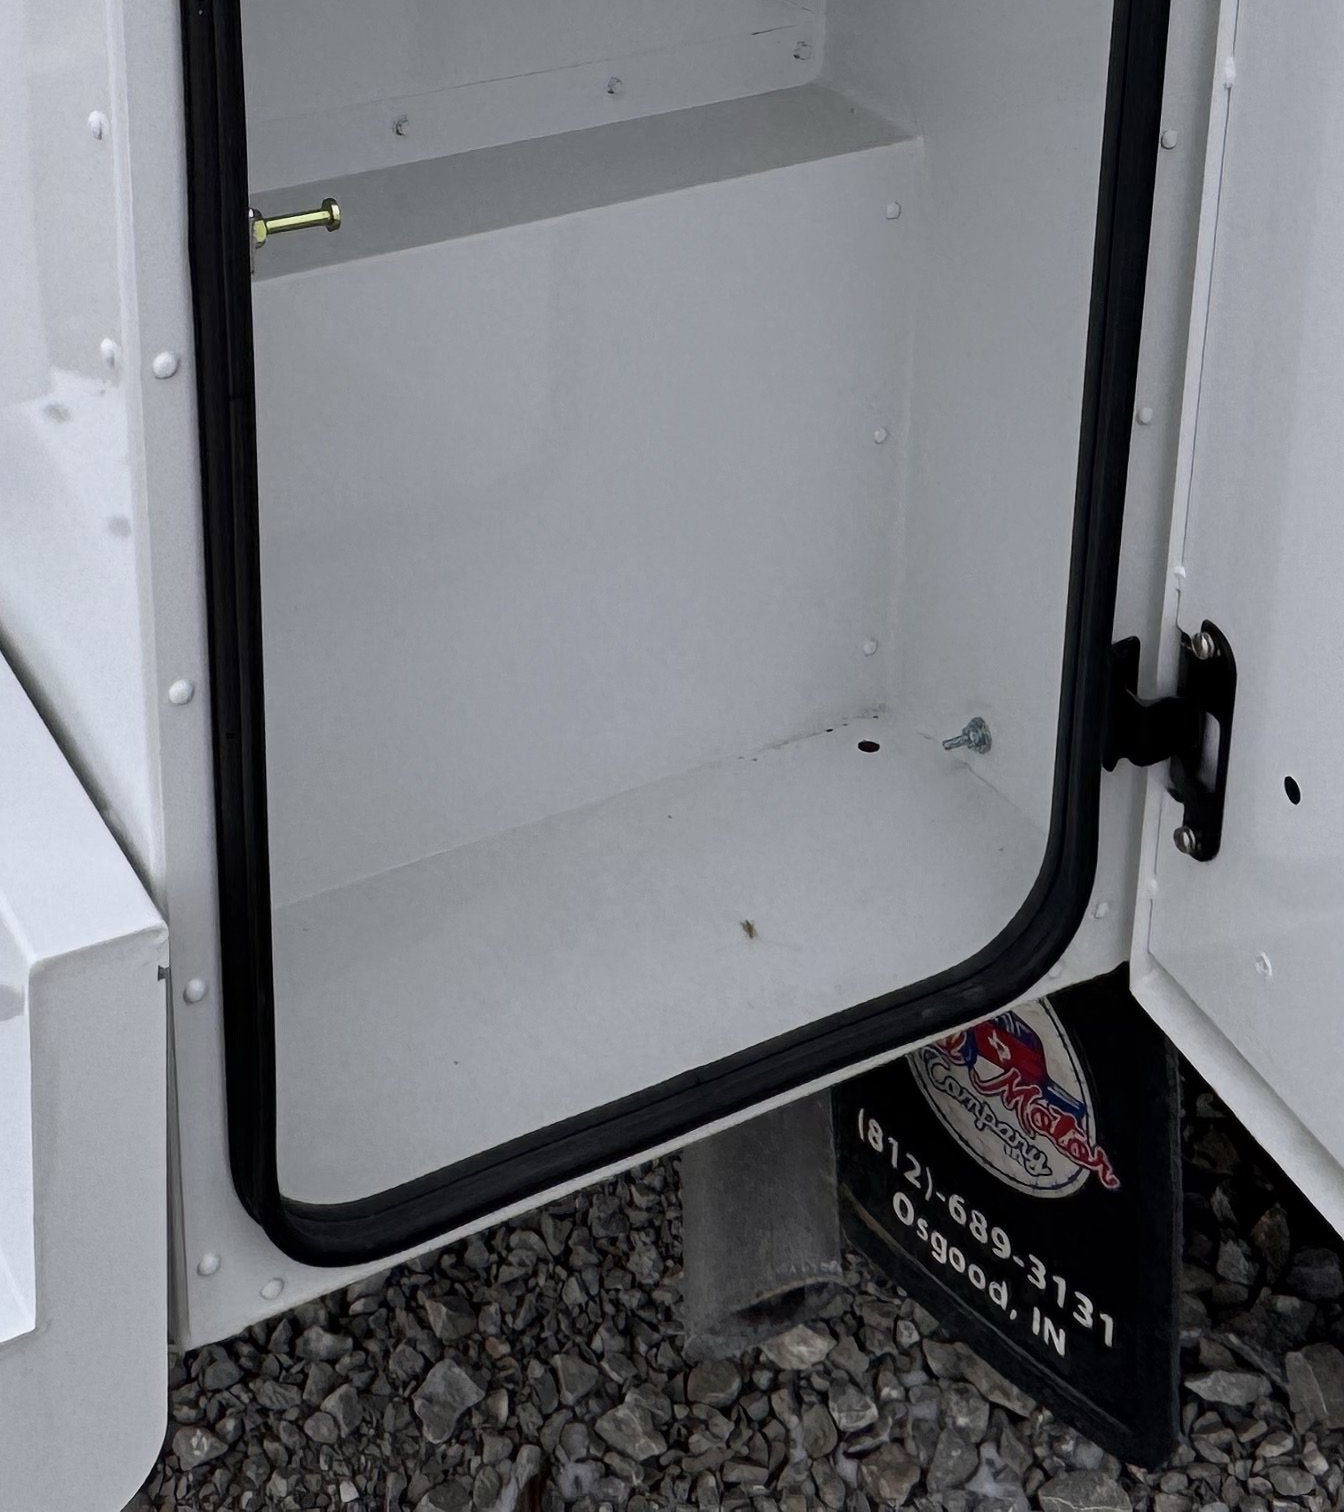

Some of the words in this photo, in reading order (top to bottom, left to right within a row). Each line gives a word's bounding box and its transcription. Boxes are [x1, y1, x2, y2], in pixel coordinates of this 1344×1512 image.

[923, 1046, 1052, 1177] Company
[970, 1066, 1121, 1189] Motor
[858, 1108, 1114, 1347] (812)-689-3131
[892, 1192, 1016, 1320] Osgood,
[1032, 1306, 1066, 1356] IN
